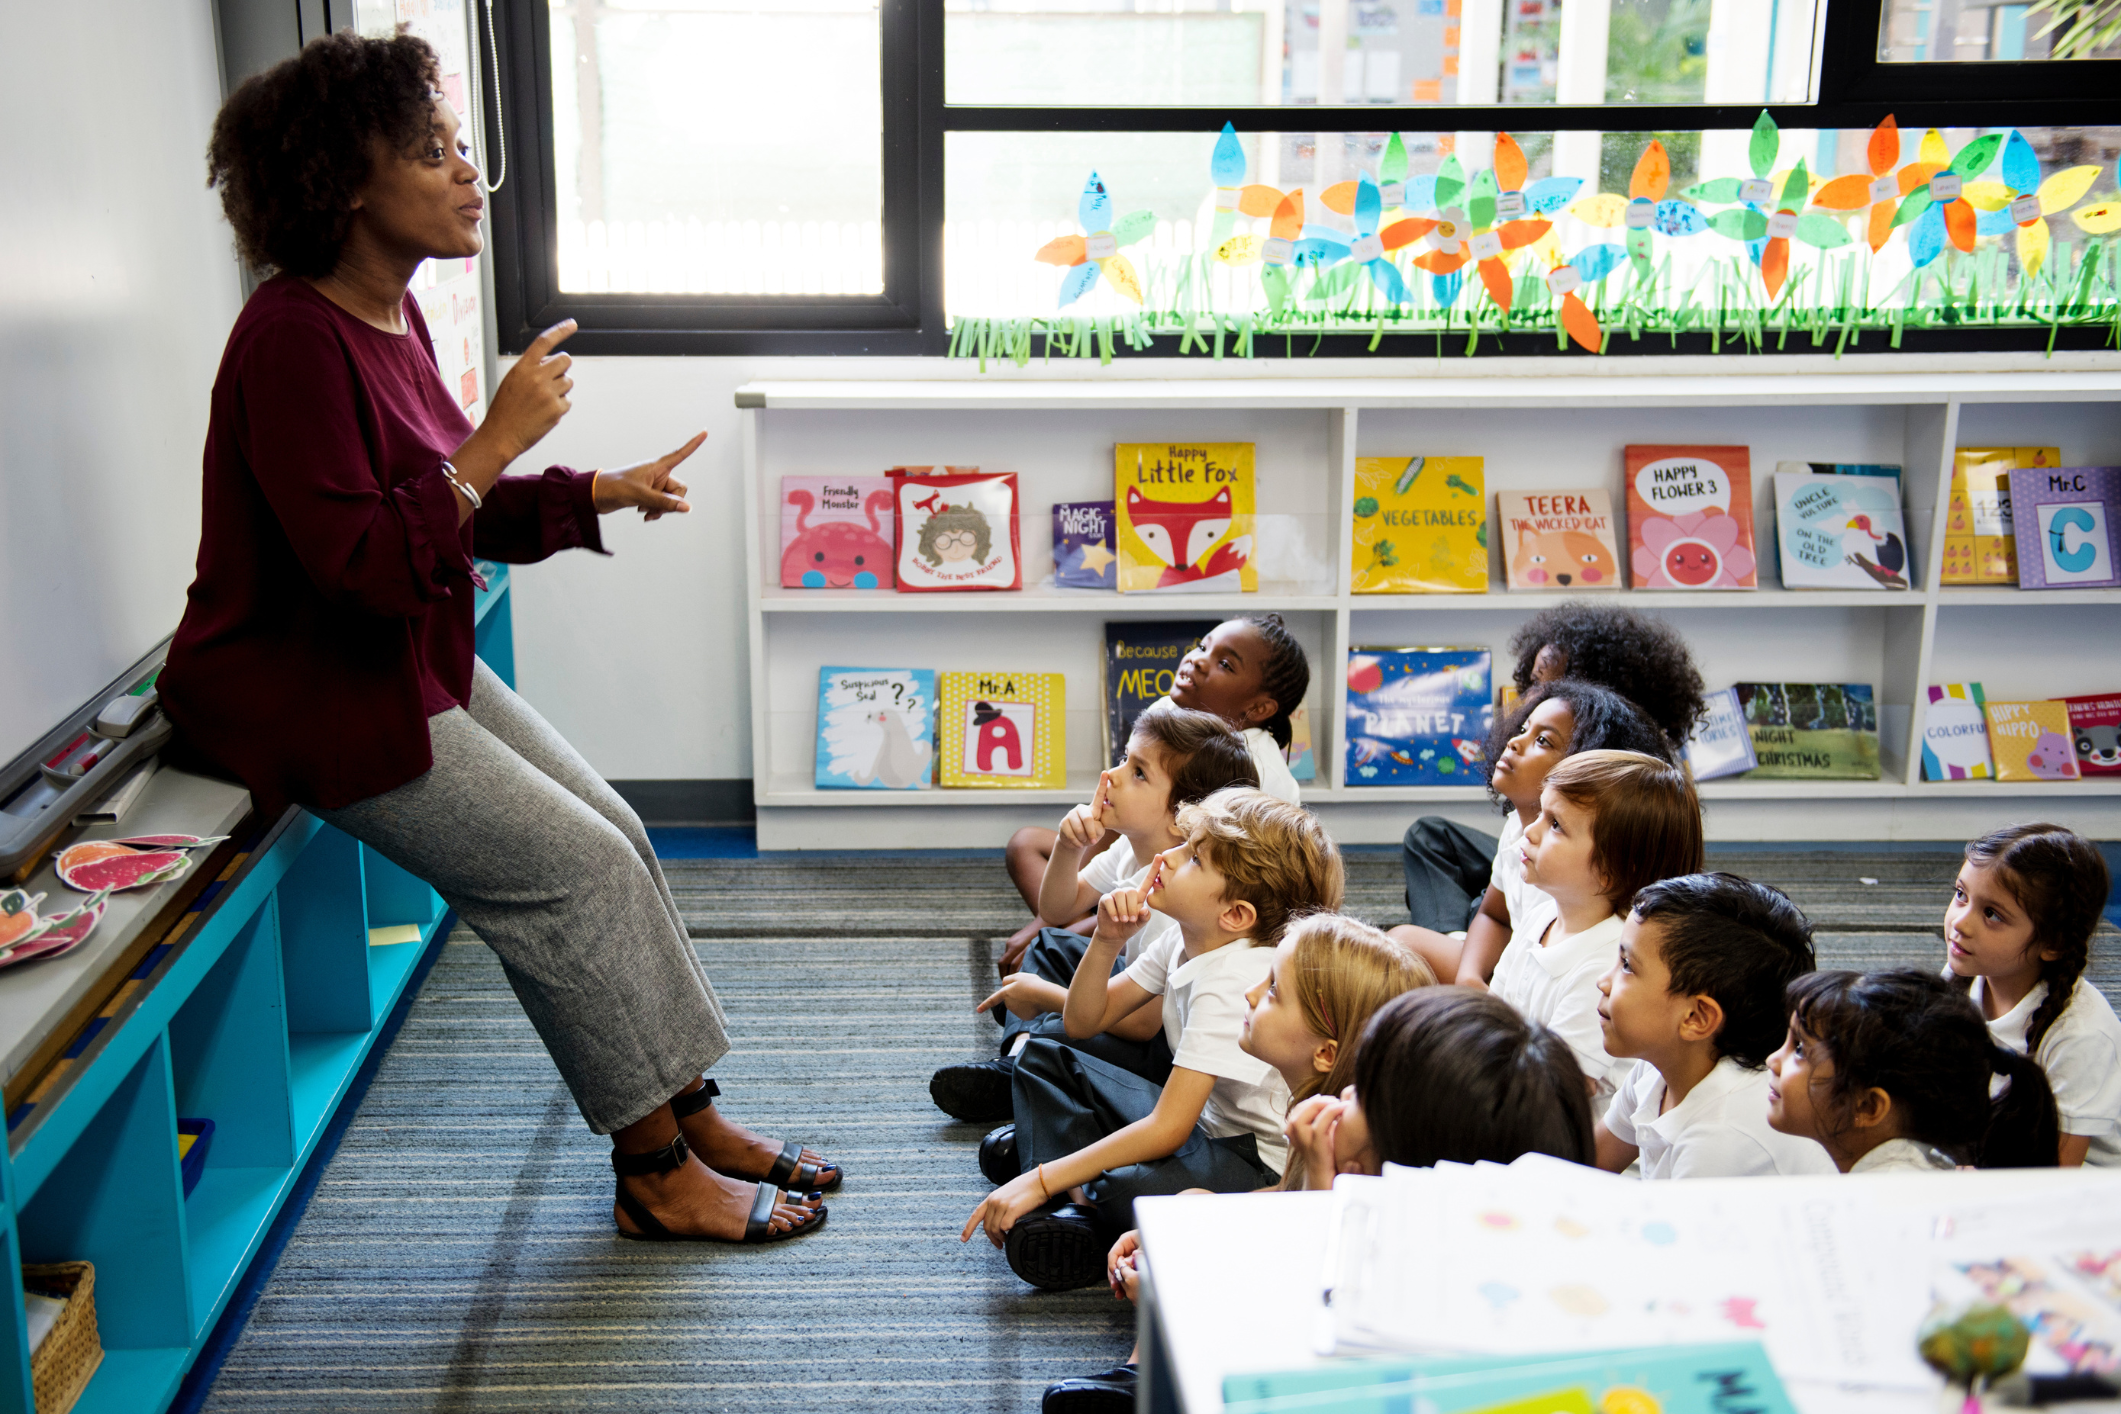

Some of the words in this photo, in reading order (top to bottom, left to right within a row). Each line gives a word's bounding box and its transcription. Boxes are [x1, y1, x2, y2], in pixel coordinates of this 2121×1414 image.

[453, 293, 478, 326] Division
[1169, 446, 1207, 462] Happy
[1138, 460, 1195, 484] Little
[1205, 462, 1238, 484] Fox
[1653, 465, 1698, 482] HAPPY
[823, 485, 859, 499] Friendly
[1651, 482, 1705, 501] FLOWER
[1709, 480, 1718, 494] 3
[2048, 475, 2086, 492] Mr.C
[822, 499, 860, 510] Monster
[1523, 496, 1591, 516] TEERA
[1794, 486, 1831, 510] UNCLE
[1059, 507, 1103, 522] MAGIC
[1381, 510, 1477, 527] VEGETABLES
[1063, 519, 1107, 535] NIGHT
[1510, 518, 1532, 531] THE
[1535, 518, 1581, 531] WICKED
[1585, 516, 1607, 530] CAT
[1796, 528, 1812, 539] ON
[1818, 533, 1836, 546] THE
[1803, 541, 1828, 555] OLD
[1798, 550, 1828, 567] TREE
[937, 571, 953, 580] THE
[956, 572, 975, 581] BEST
[1116, 639, 1178, 659] Because
[841, 678, 889, 691] Suspicious
[979, 679, 1016, 696] Mr.A
[1116, 669, 1175, 700] MEO
[856, 690, 877, 702] Seal
[1990, 704, 2030, 723] HIPPY
[1365, 711, 1465, 738] PLANET
[1927, 722, 1985, 739] COLORFU
[1997, 720, 2039, 738] HIPPO
[1700, 724, 1738, 744] TORIES
[1755, 731, 1794, 744] NIGHT
[1757, 753, 1831, 768] CHRISTMAS
